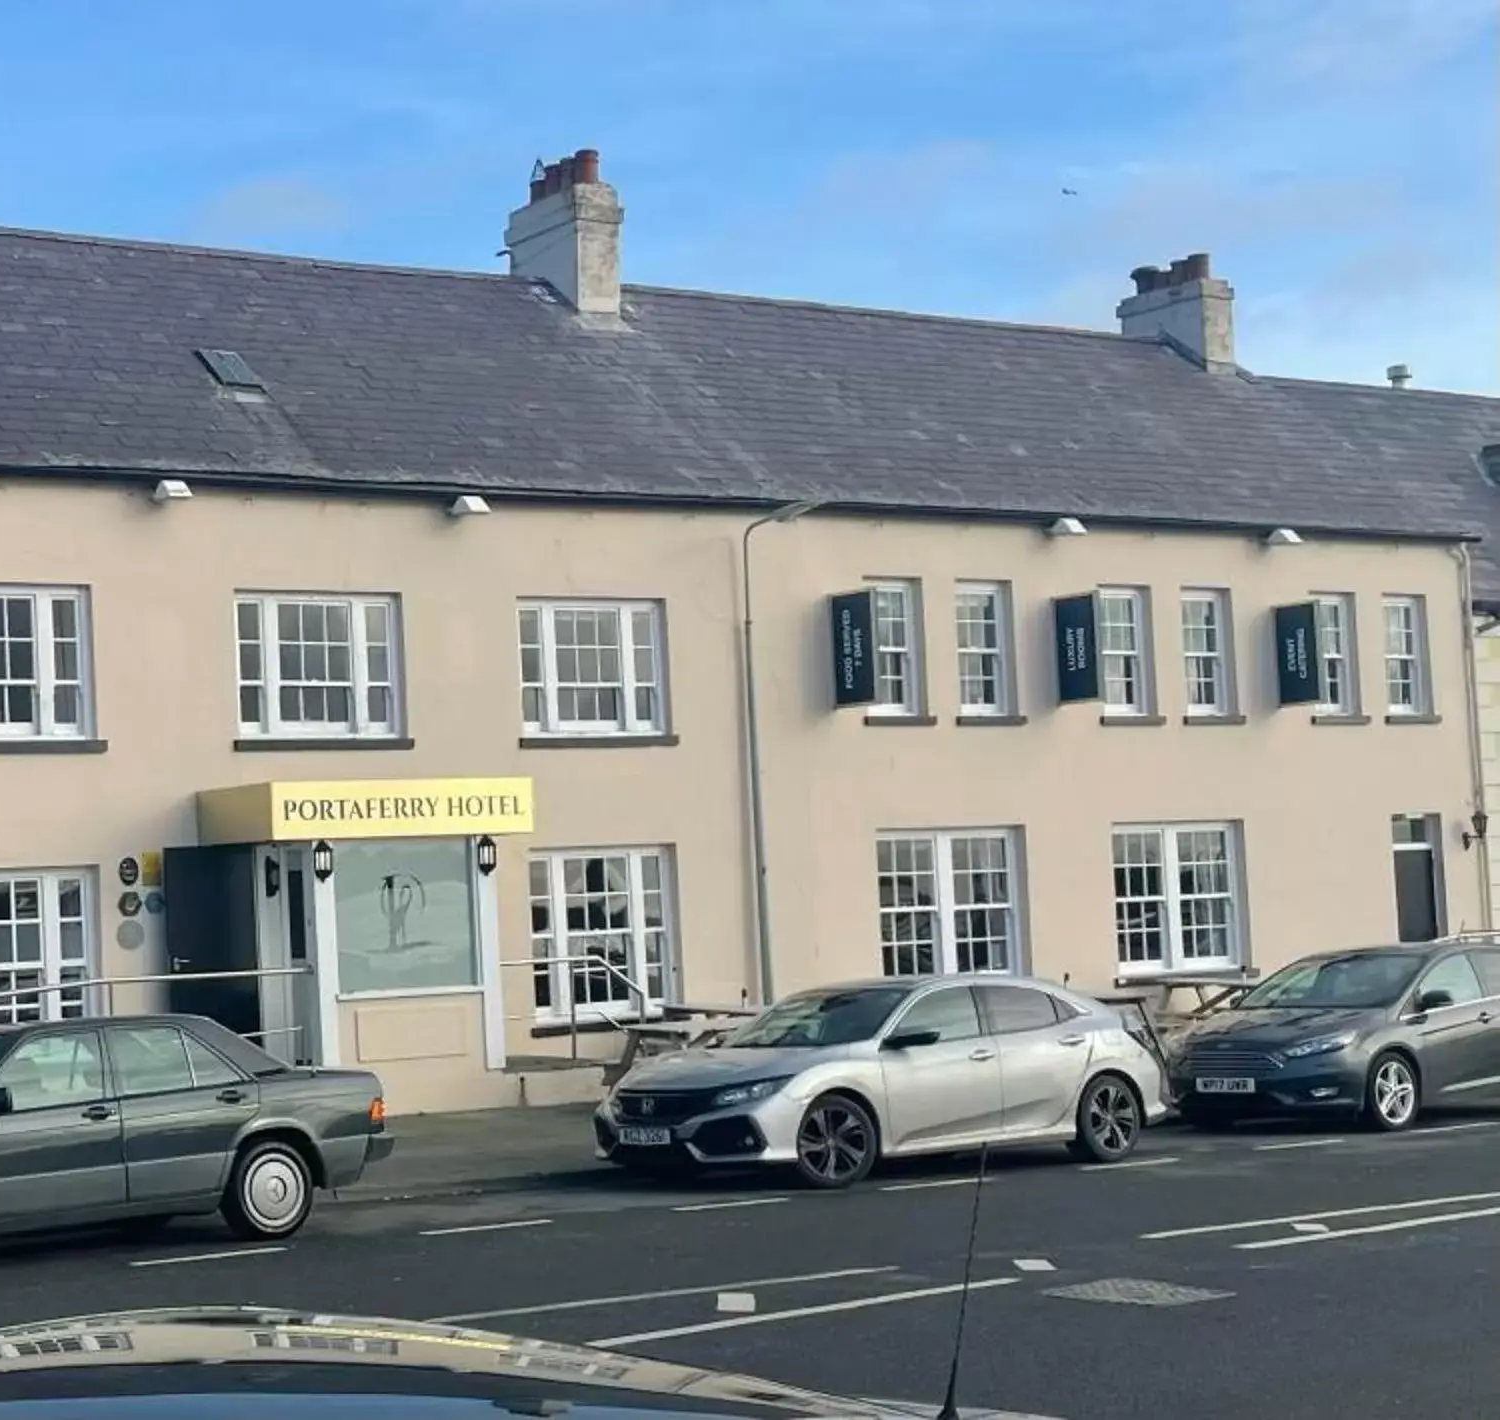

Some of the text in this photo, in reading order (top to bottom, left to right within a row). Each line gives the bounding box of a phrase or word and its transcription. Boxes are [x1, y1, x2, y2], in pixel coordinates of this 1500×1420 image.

[842, 609, 853, 689] FOOD SERVED
[853, 628, 863, 658] DAYS
[1066, 627, 1076, 671] LUXURY
[1076, 627, 1086, 669] ROOMS
[1286, 638, 1296, 672] EVENT
[1296, 627, 1307, 679] CATERING
[283, 795, 526, 821] PORTAFERRY HOTEL
